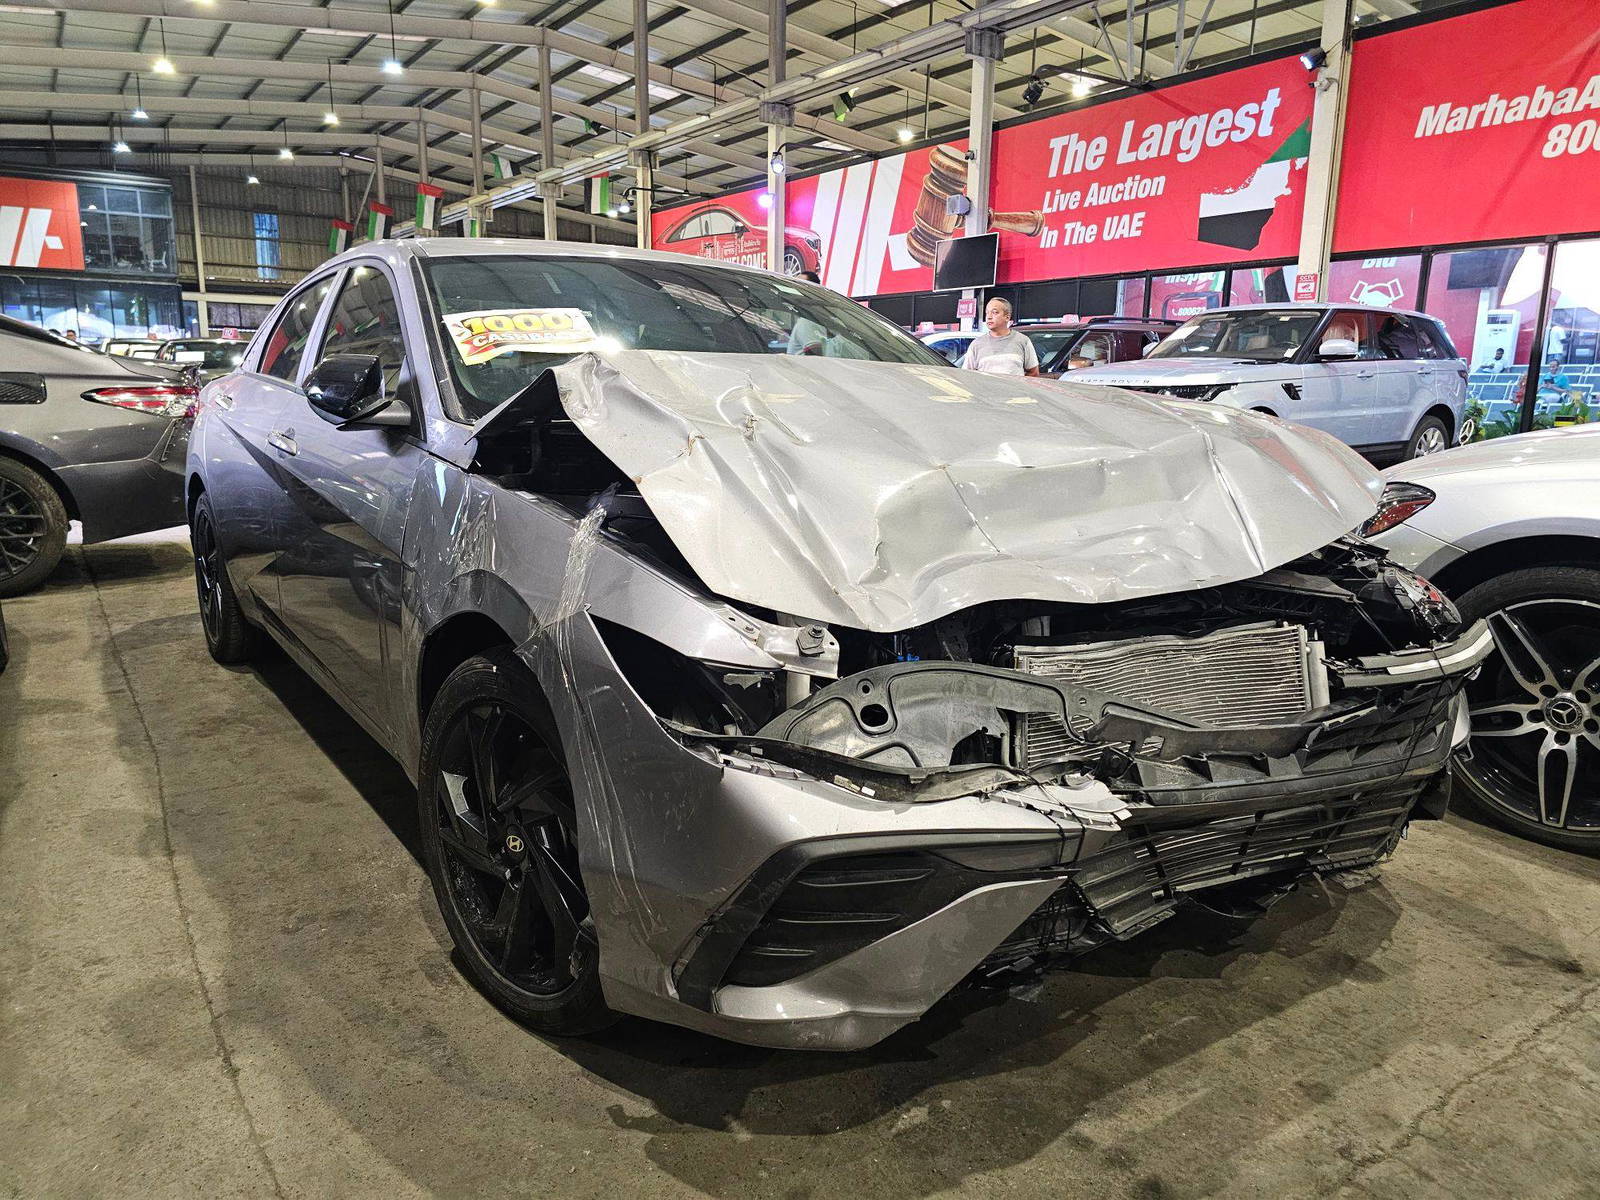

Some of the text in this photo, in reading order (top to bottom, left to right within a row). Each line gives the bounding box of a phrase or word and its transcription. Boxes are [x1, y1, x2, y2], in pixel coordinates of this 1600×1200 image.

[1048, 88, 1281, 178] The Largest
[1541, 119, 1600, 159] 80
[1042, 175, 1166, 213] Live Auction
[1040, 212, 1145, 249] In The UAE
[463, 313, 573, 335] 1000
[472, 331, 585, 347] CASHBA
